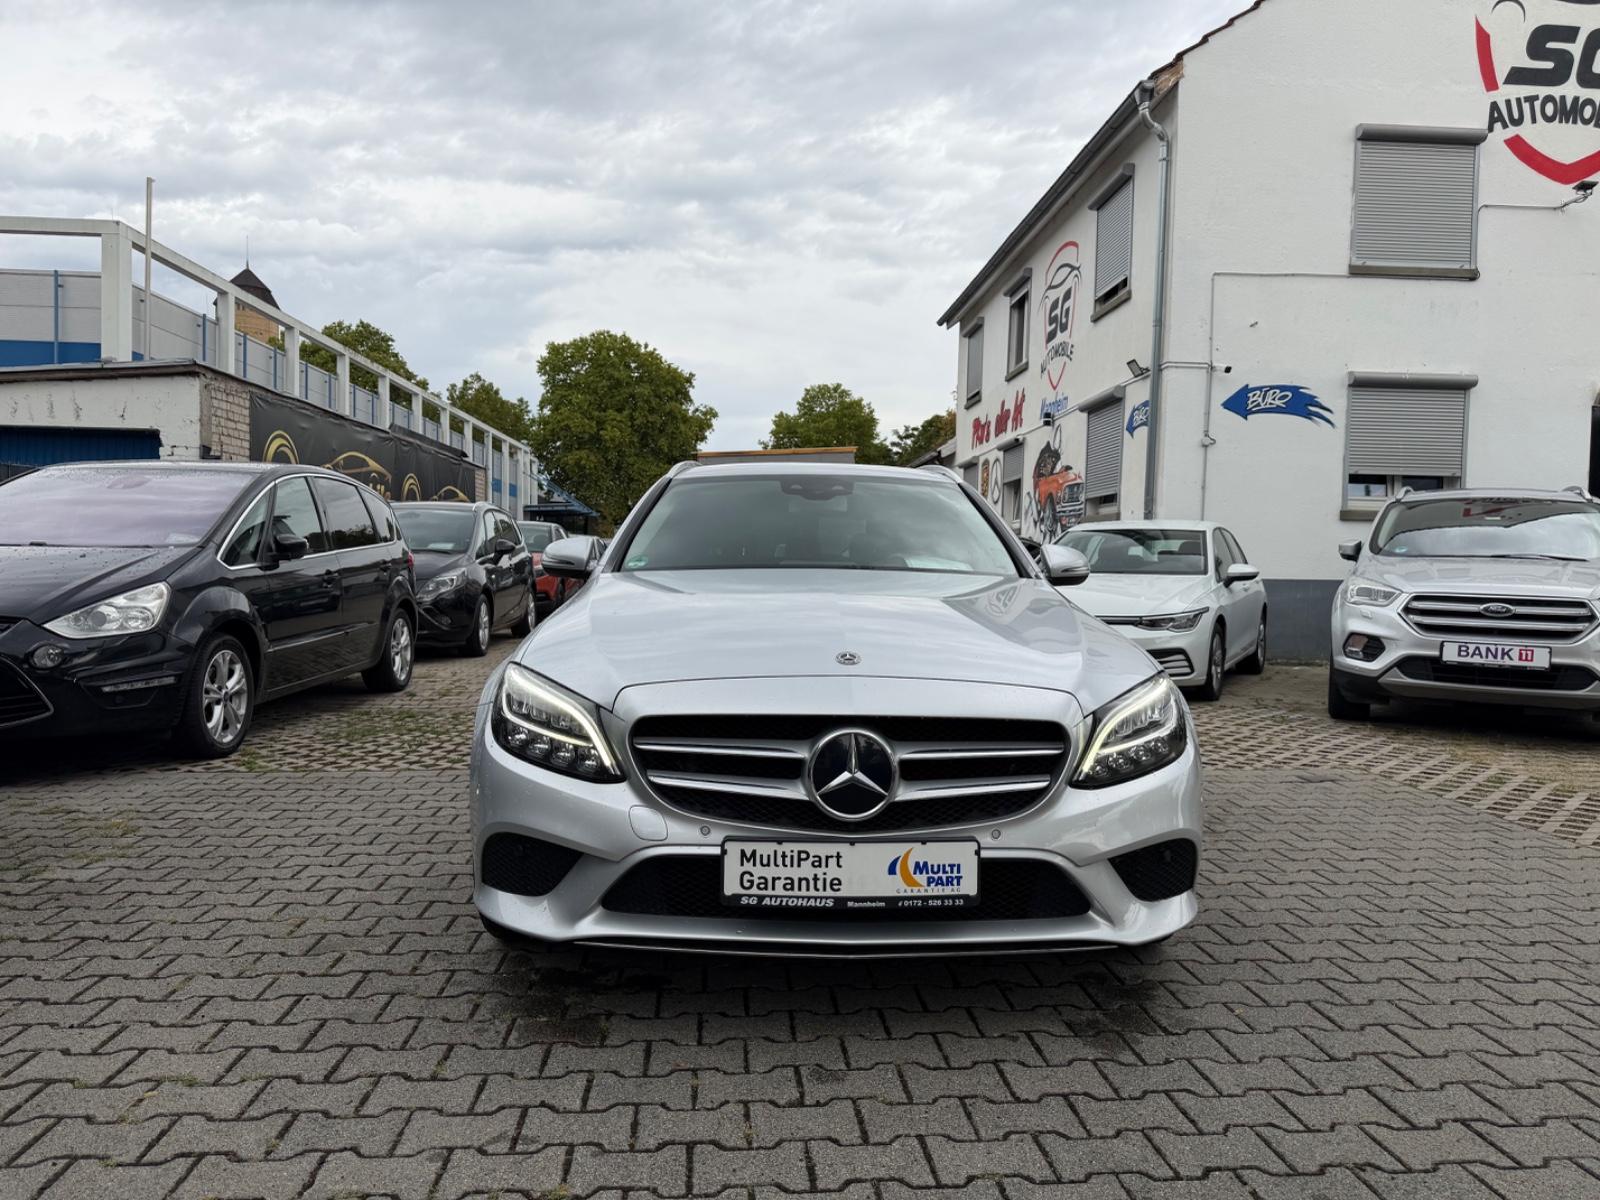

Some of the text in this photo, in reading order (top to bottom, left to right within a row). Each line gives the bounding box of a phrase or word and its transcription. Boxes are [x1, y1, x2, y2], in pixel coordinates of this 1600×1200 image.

[1487, 94, 1600, 133] AUTOMO
[1046, 286, 1072, 345] SG
[1457, 644, 1514, 661] BANK
[740, 848, 843, 868] MultiPart
[739, 870, 843, 892] Garantie
[926, 875, 963, 887] PART
[740, 896, 835, 907] SG AUTOHAUS
